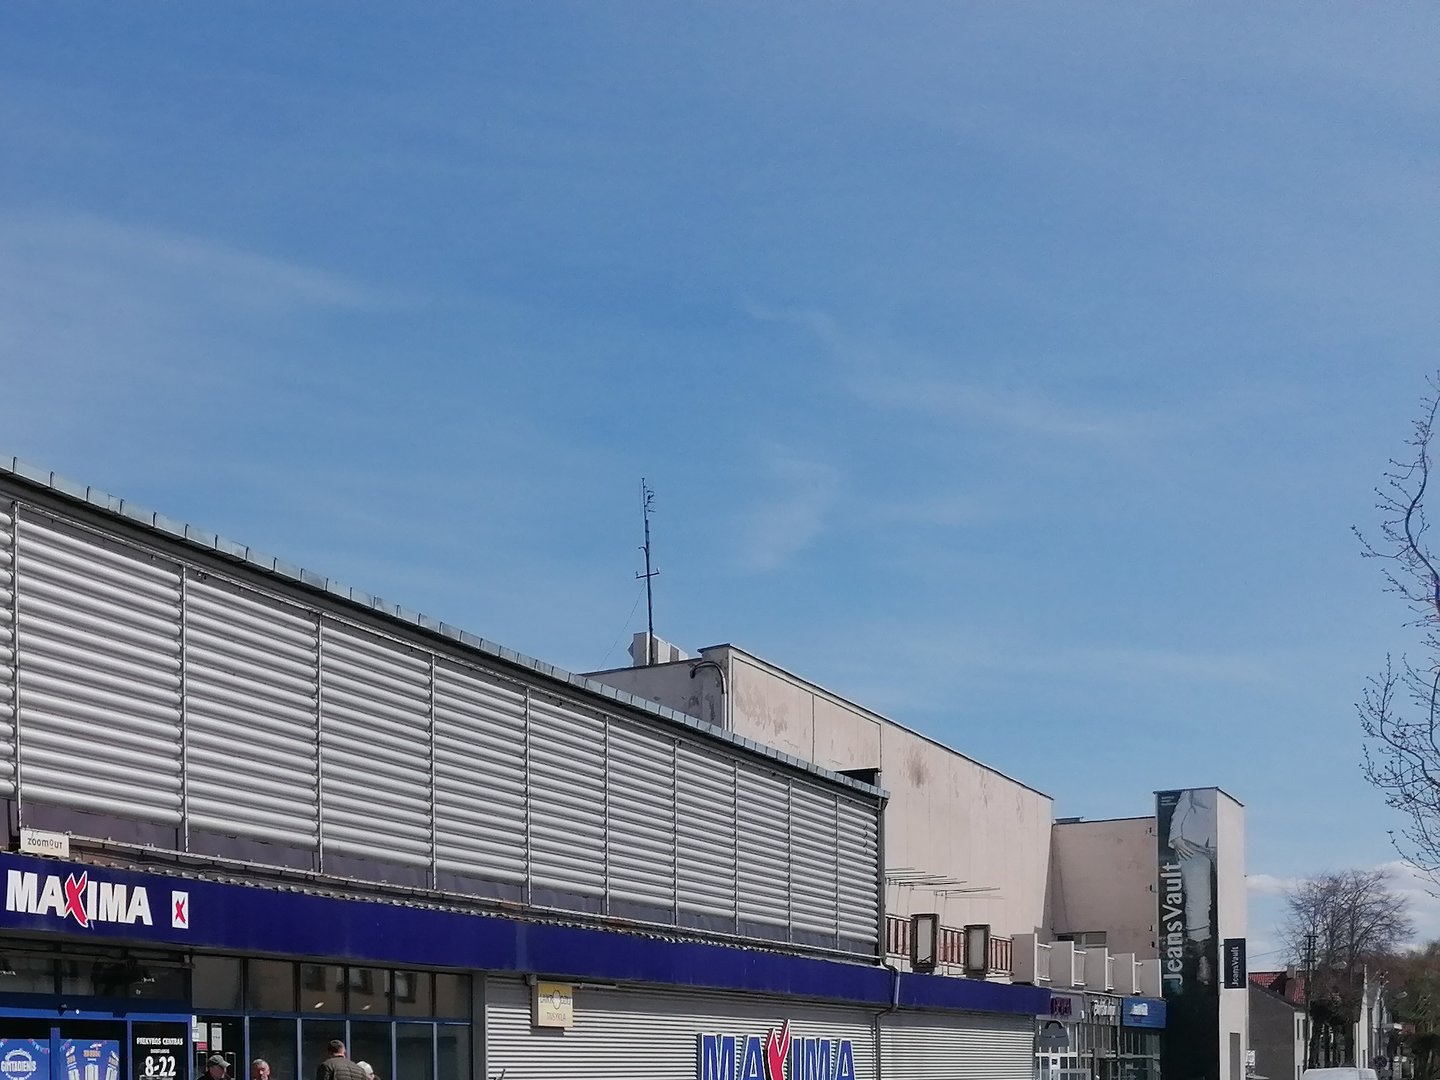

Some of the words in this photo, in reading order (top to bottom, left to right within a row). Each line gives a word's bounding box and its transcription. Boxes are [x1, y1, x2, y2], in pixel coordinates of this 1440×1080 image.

[6, 870, 153, 928] MAXIMA
[1160, 862, 1183, 985] JeansVault
[144, 1055, 177, 1077] 8-22
